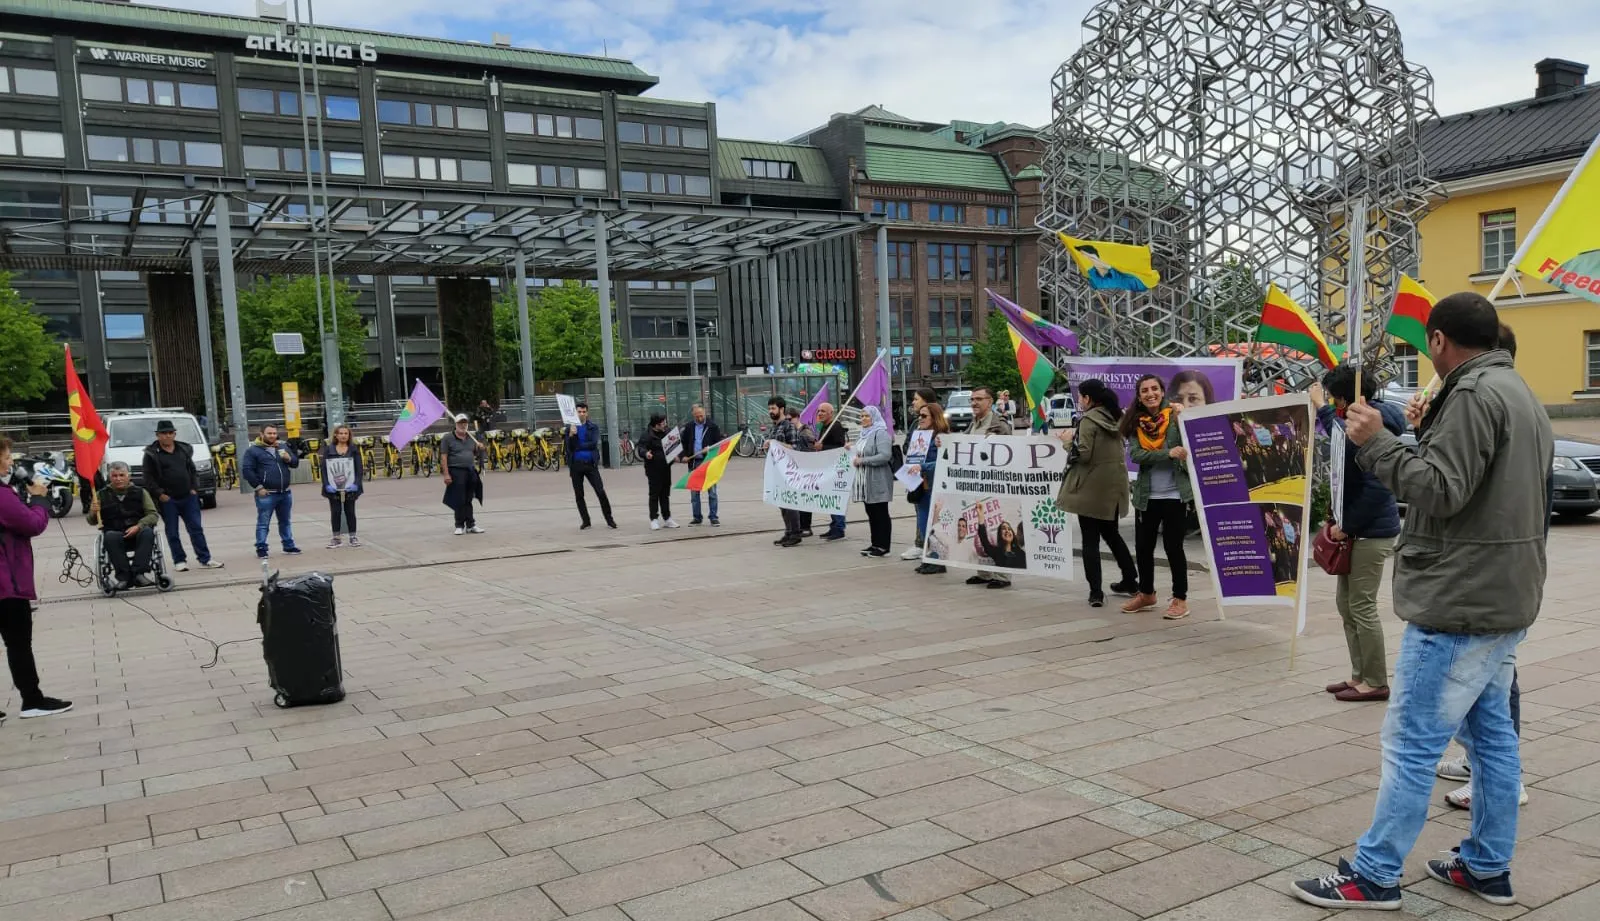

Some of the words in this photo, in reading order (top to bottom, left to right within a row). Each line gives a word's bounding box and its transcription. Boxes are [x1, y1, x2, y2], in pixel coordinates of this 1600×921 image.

[245, 31, 353, 60] arkadia
[359, 40, 378, 62] 6
[113, 51, 166, 65] WARNER
[168, 56, 207, 69] MUSIC
[815, 349, 856, 360] CIRCUS
[980, 469, 1021, 482] poliittisten
[955, 481, 1005, 494] vapauttamista
[1006, 484, 1051, 496] Turkissa!
